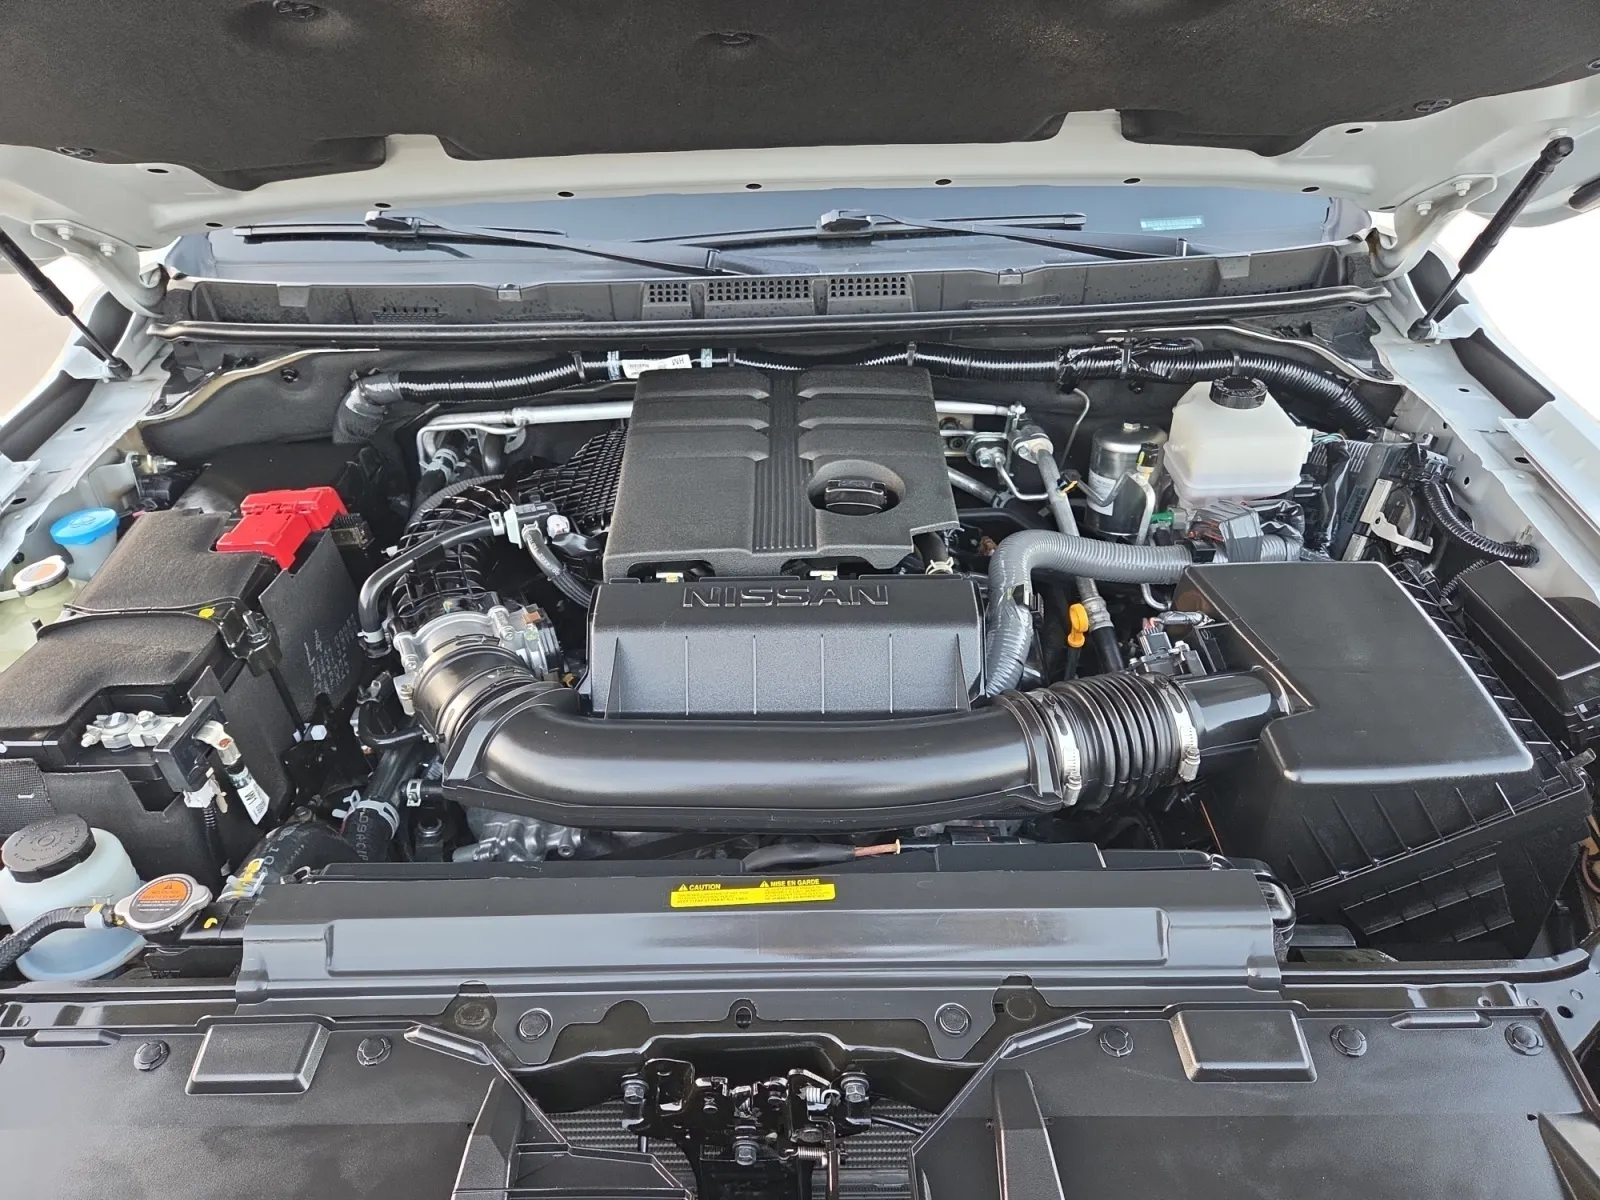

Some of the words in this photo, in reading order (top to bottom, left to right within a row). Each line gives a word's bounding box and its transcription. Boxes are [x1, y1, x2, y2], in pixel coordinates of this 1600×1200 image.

[682, 585, 889, 608] NISSAN
[797, 878, 820, 886] GARDE
[689, 883, 721, 891] CAUTION
